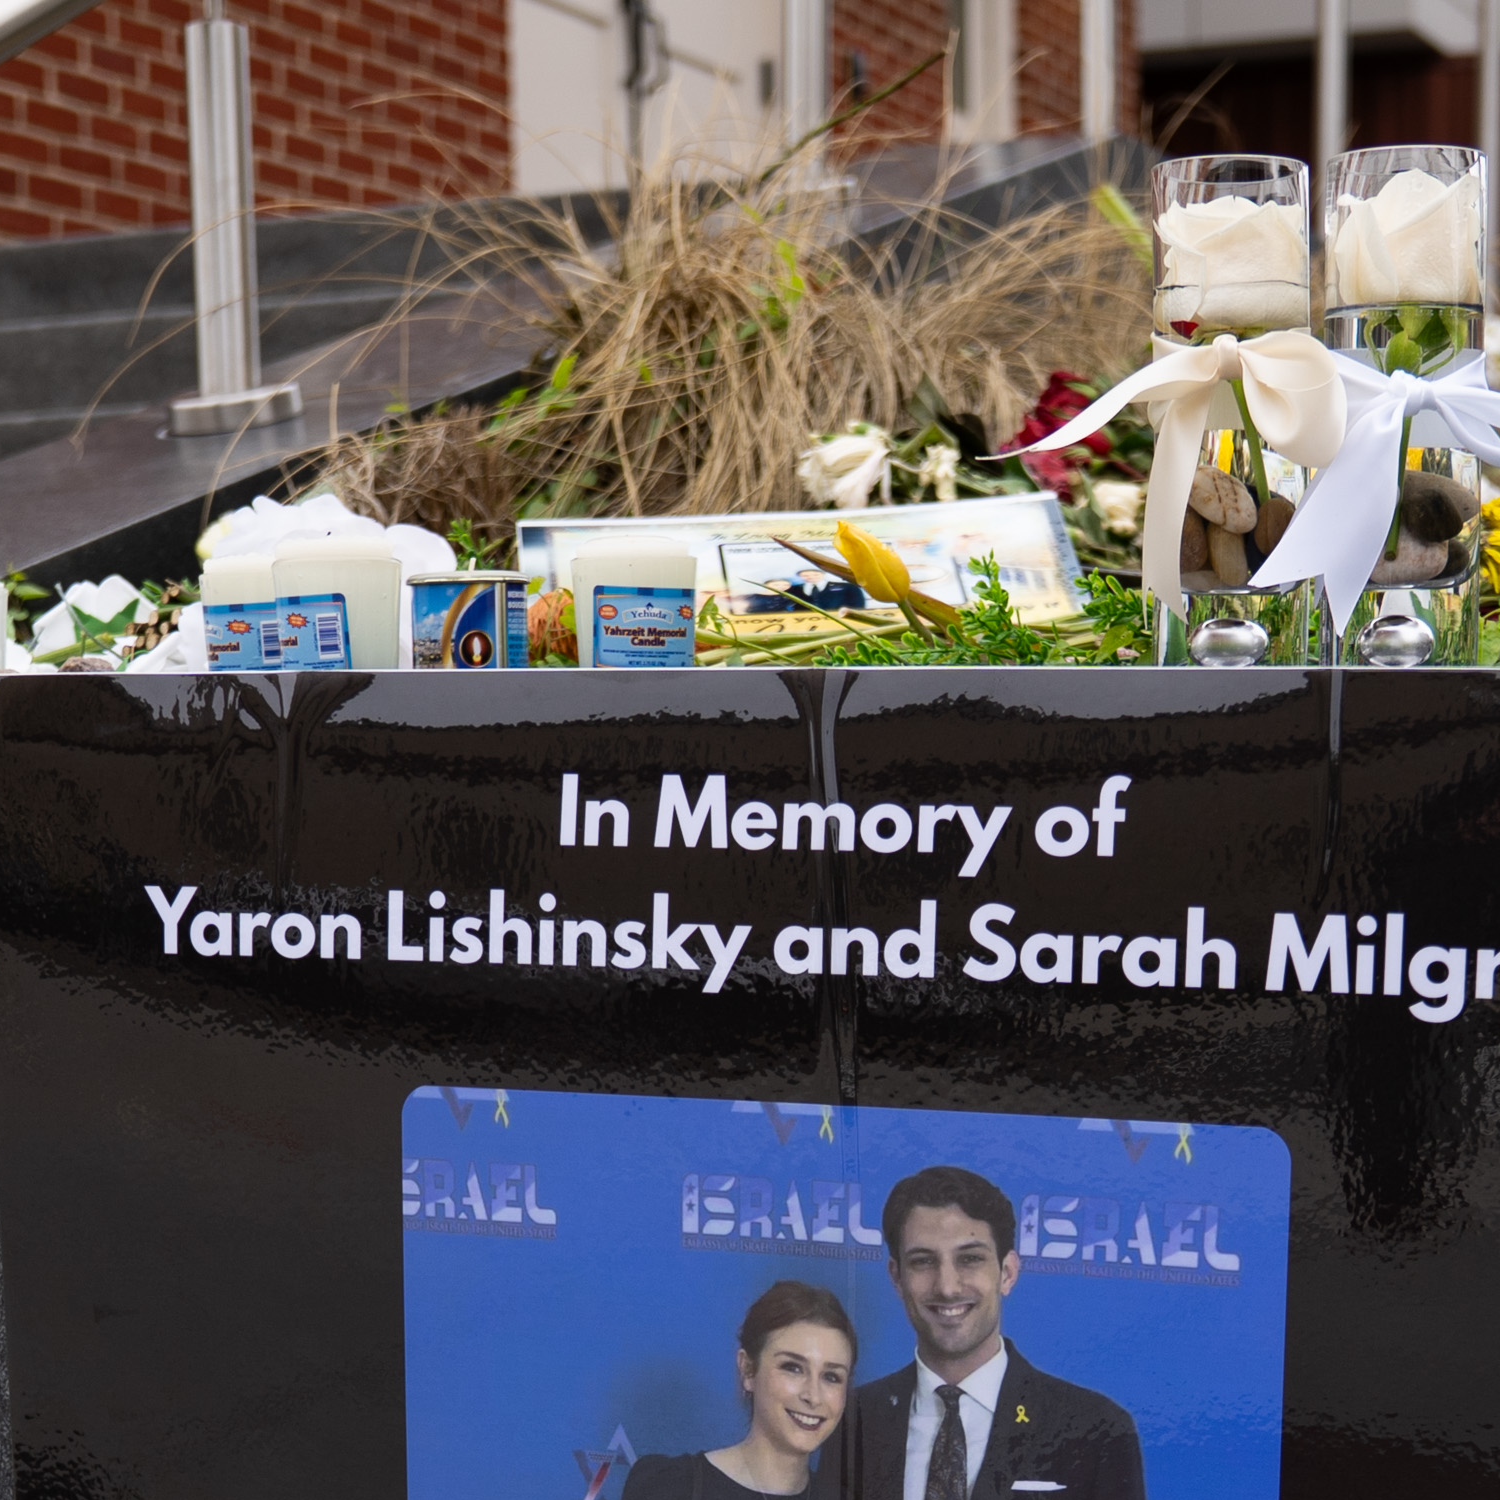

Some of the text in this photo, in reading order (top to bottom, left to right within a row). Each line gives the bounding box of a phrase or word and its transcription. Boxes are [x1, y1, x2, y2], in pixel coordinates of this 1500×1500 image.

[631, 609, 667, 619] Yehuda
[603, 625, 687, 638] Yahrzeit Memorial
[630, 636, 666, 646] Candle
[559, 773, 1132, 878] In Memory of
[143, 885, 362, 960] Yaron
[387, 888, 752, 994] Lishinsky
[773, 899, 937, 979] and
[962, 903, 1237, 989] Sarah
[403, 1158, 557, 1226] SRAEL
[682, 1173, 882, 1246] ISRAEL
[490, 1224, 525, 1237] UNITED
[528, 1227, 557, 1239] STATES
[1019, 1194, 1240, 1271] ISRAEL
[682, 1236, 722, 1248] EMBASSY
[740, 1239, 770, 1251] ISRAEL
[789, 1244, 807, 1255] THE
[810, 1244, 847, 1258] UNITED
[849, 1248, 882, 1261] STATES
[1083, 1263, 1113, 1277] ISRAEL
[1136, 1269, 1154, 1280] THE
[1159, 1269, 1201, 1284] UNITED
[1204, 1274, 1240, 1287] STATES
